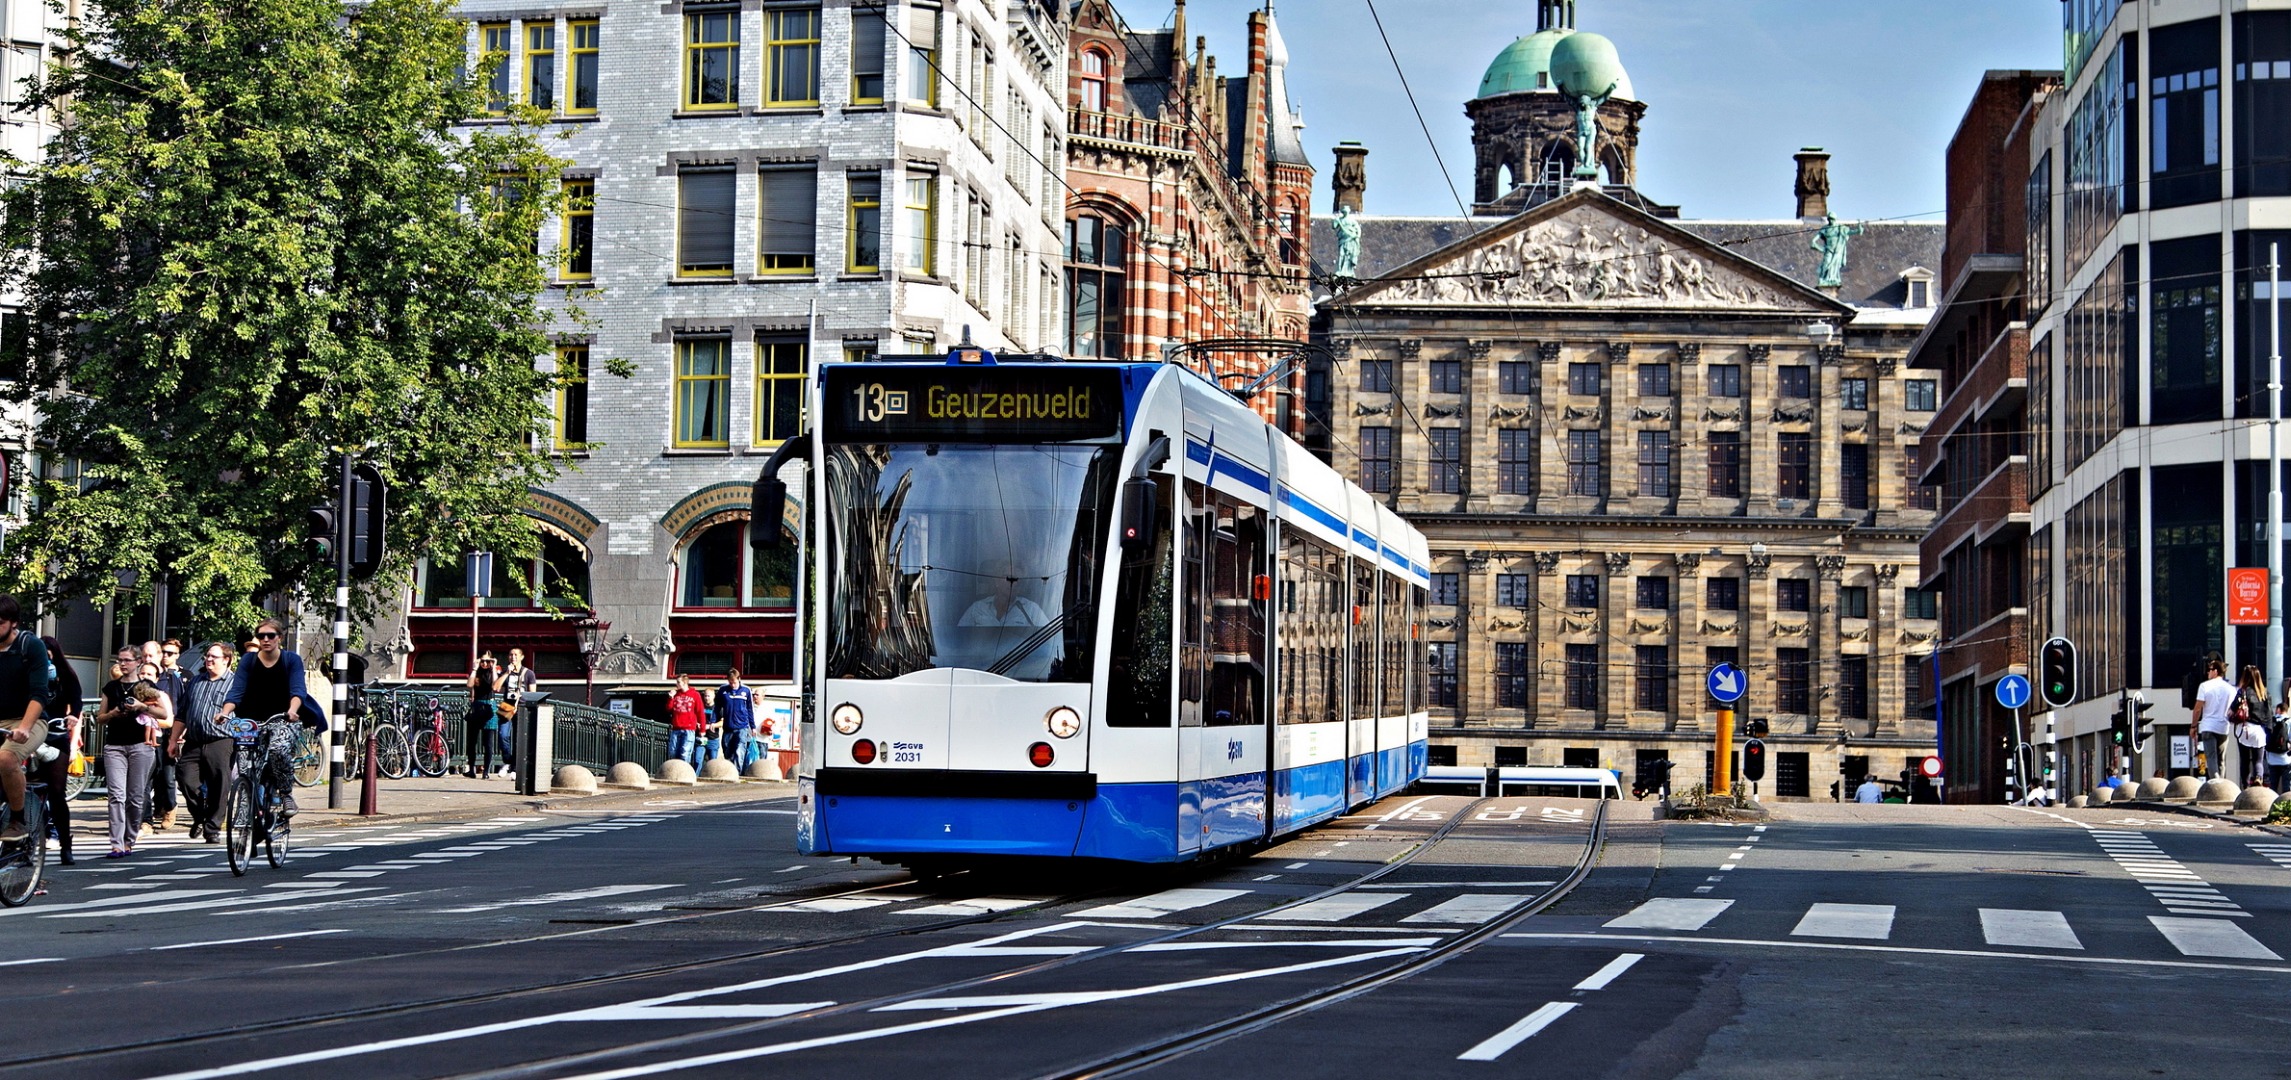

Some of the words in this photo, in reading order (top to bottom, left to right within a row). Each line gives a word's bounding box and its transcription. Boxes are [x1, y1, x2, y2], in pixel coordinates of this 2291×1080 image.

[853, 383, 885, 422] 13
[928, 385, 1090, 419] Geuzenveld
[894, 752, 921, 762] 2031
